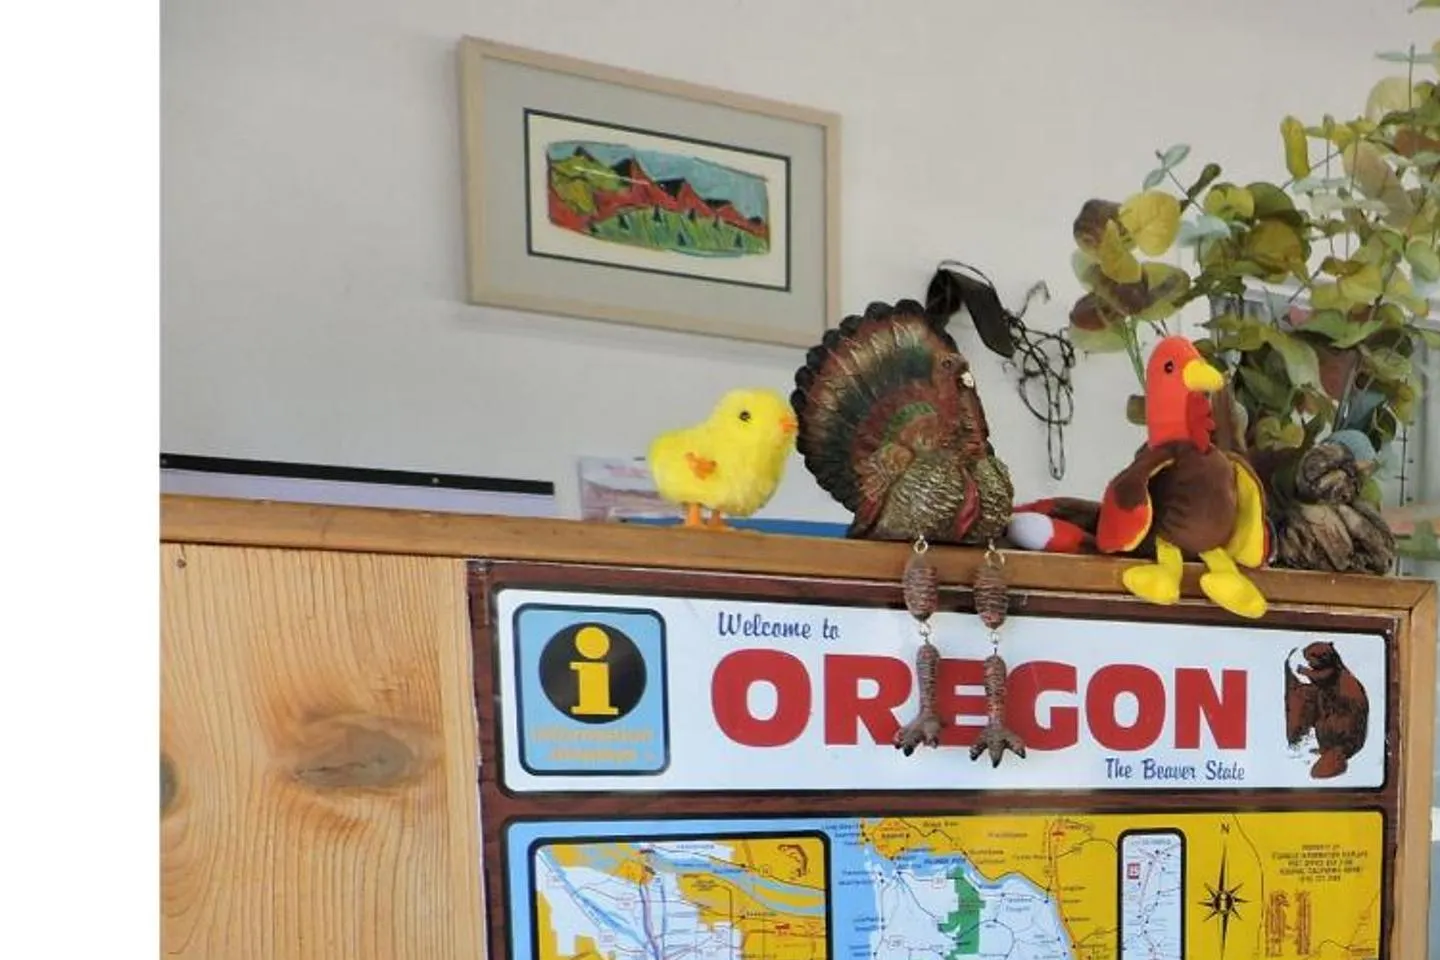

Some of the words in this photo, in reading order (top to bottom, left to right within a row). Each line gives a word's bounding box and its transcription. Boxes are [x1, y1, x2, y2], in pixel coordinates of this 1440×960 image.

[718, 611, 812, 640] Welcome
[822, 618, 841, 640] to
[711, 647, 1248, 752] OREGON
[1105, 757, 1133, 780] The
[1142, 758, 1197, 782] Beaver
[1205, 760, 1246, 782] State
